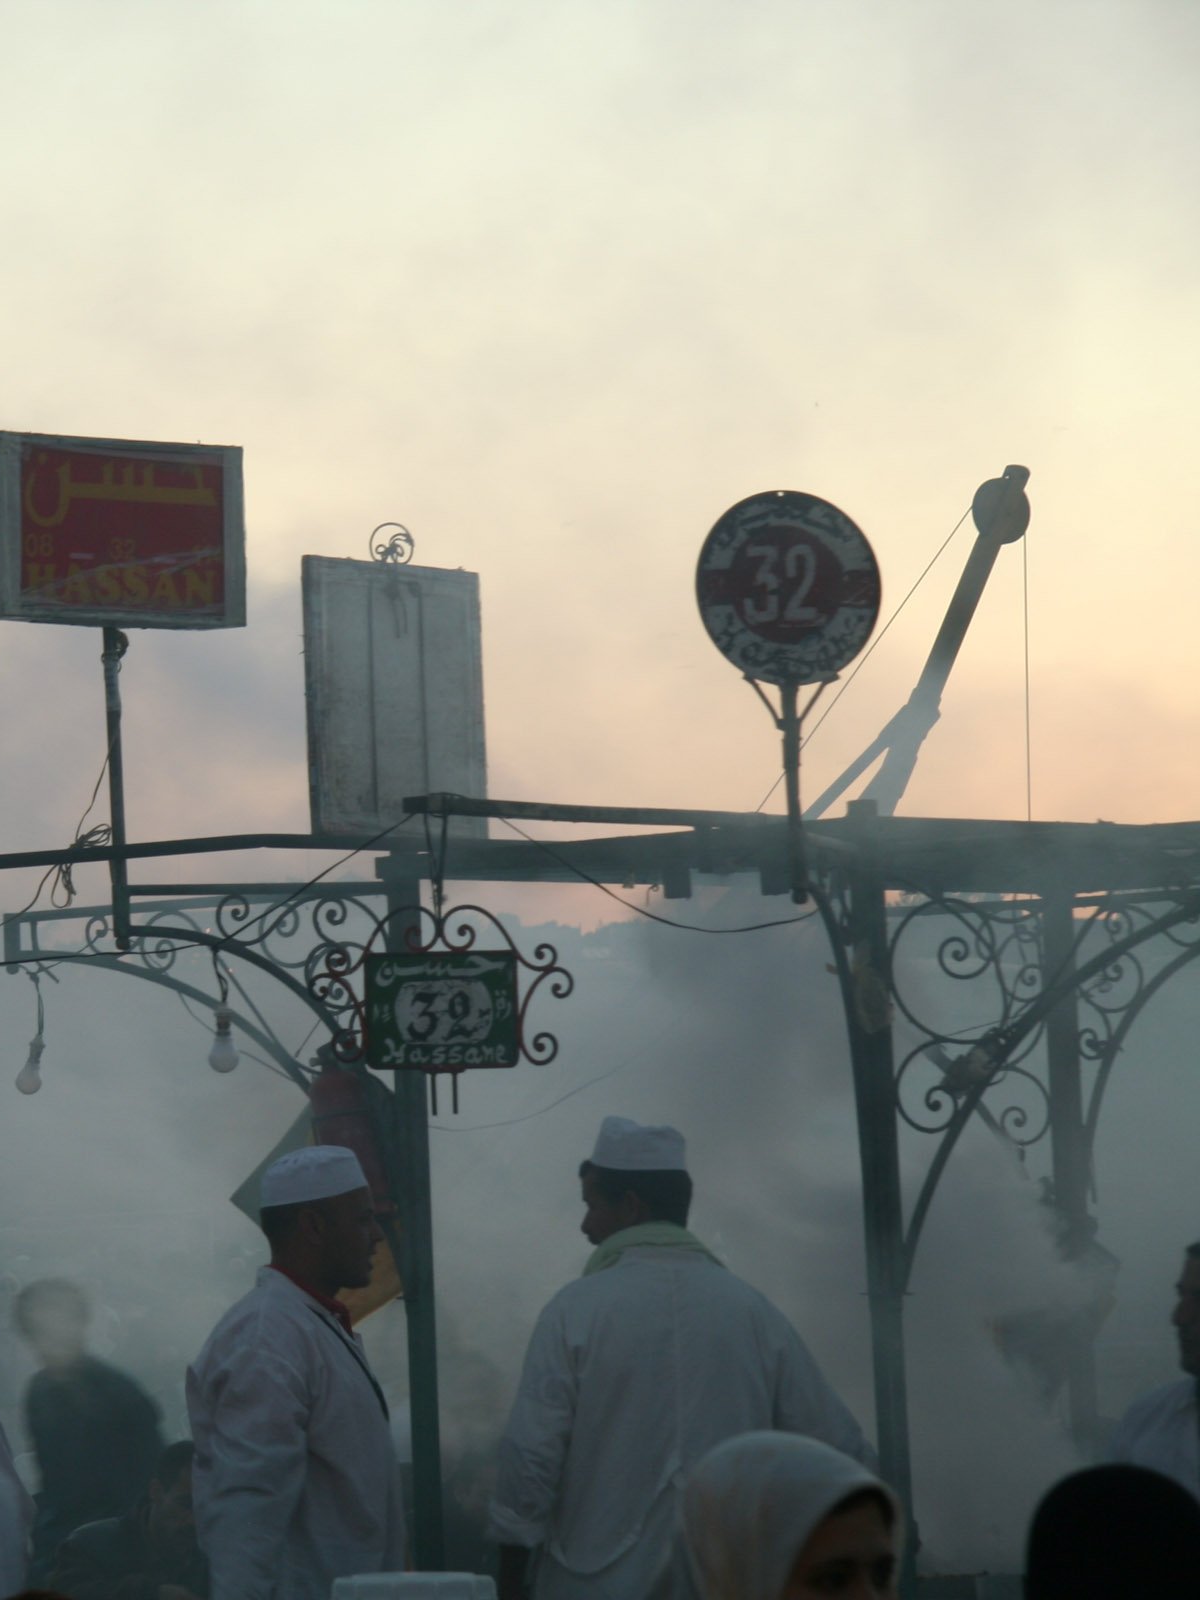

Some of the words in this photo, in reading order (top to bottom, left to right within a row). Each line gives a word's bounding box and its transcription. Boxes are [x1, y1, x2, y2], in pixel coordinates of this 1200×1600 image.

[25, 562, 217, 608] HASSAN
[744, 543, 818, 624] 32
[374, 955, 507, 988] حسن
[406, 989, 480, 1043] 32
[380, 1037, 510, 1064] Hassane
